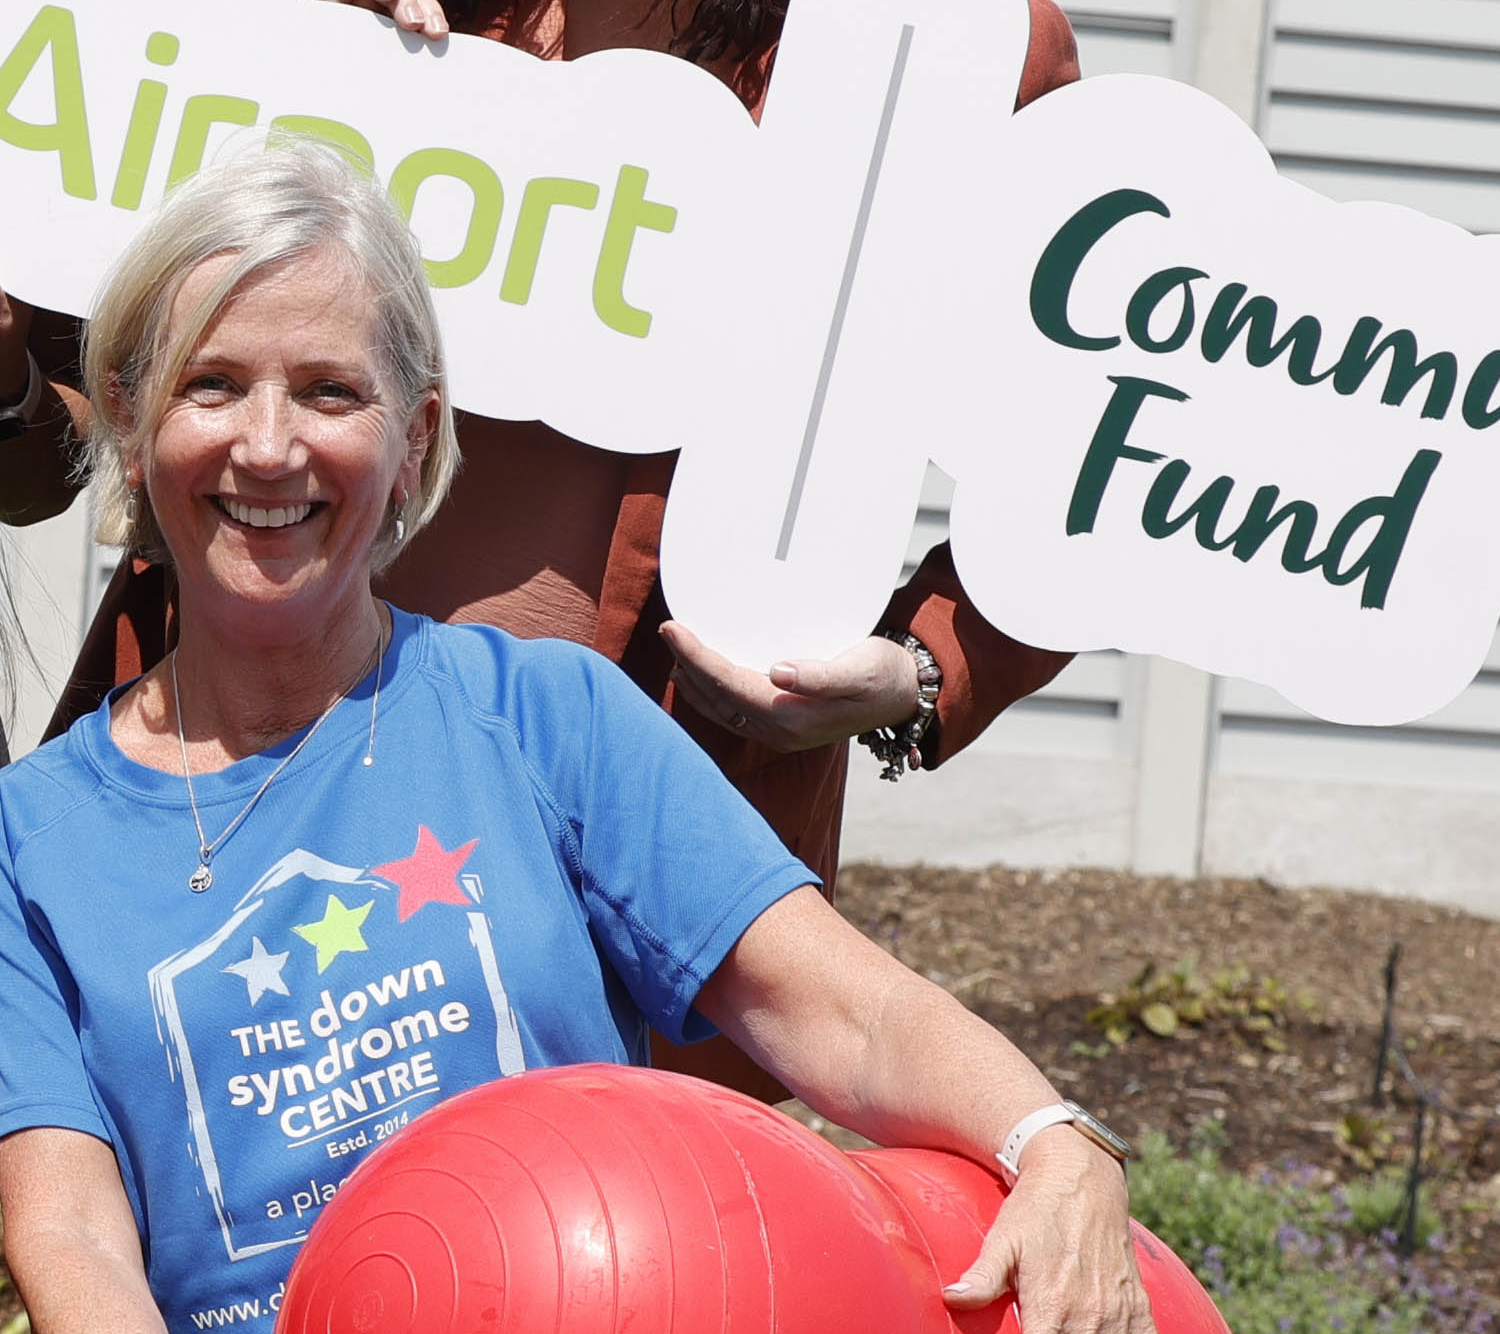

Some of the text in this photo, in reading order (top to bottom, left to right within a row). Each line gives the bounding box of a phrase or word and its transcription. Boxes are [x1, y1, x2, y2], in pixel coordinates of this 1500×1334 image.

[1065, 375, 1441, 611] Fund
[230, 959, 446, 1057] THE down
[227, 1001, 471, 1116] syndrome
[279, 1051, 440, 1139] CENTRE
[325, 1110, 409, 1159] Estd. 2014
[265, 1178, 348, 1219] a pla
